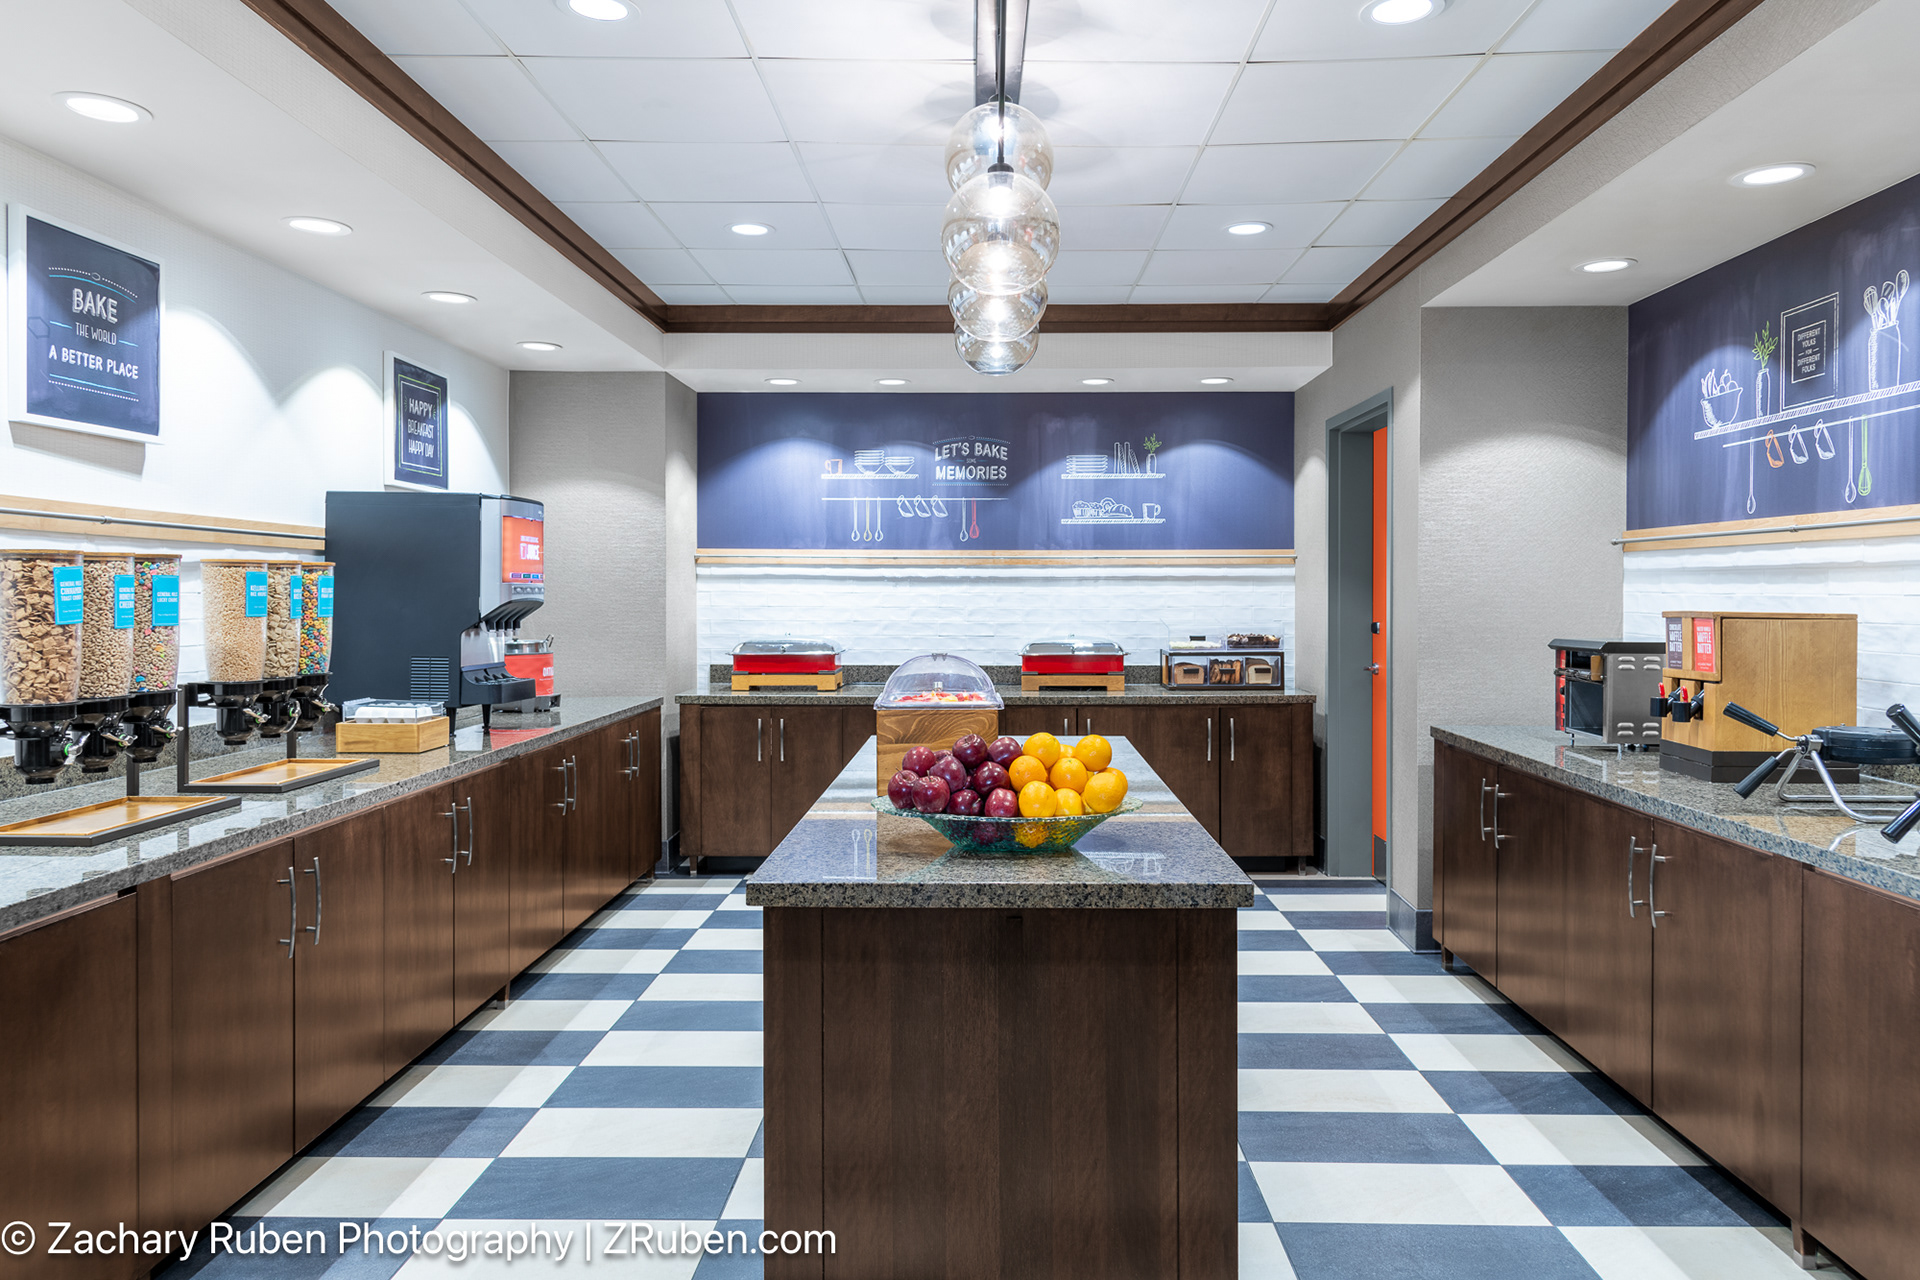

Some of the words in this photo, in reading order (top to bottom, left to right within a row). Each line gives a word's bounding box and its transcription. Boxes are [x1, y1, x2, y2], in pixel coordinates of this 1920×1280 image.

[72, 288, 118, 324] BAKE
[75, 322, 89, 339] THE
[91, 328, 117, 345] WORLD
[1797, 327, 1821, 341] DIFFERENT
[1802, 337, 1816, 348] YOLKS
[48, 344, 58, 361] A
[61, 346, 103, 371] BETTER
[106, 359, 139, 380] PLACE
[1797, 353, 1820, 367] DIFFERENT
[1801, 363, 1816, 373] FOLKS
[409, 398, 433, 419] HAPPY
[407, 419, 434, 439] BREAKFAST
[408, 439, 424, 456] HAPPY
[425, 442, 434, 458] DAY
[935, 442, 970, 461] LET'S
[974, 442, 1008, 461] BAKE
[935, 465, 1007, 480] MEMORIES
